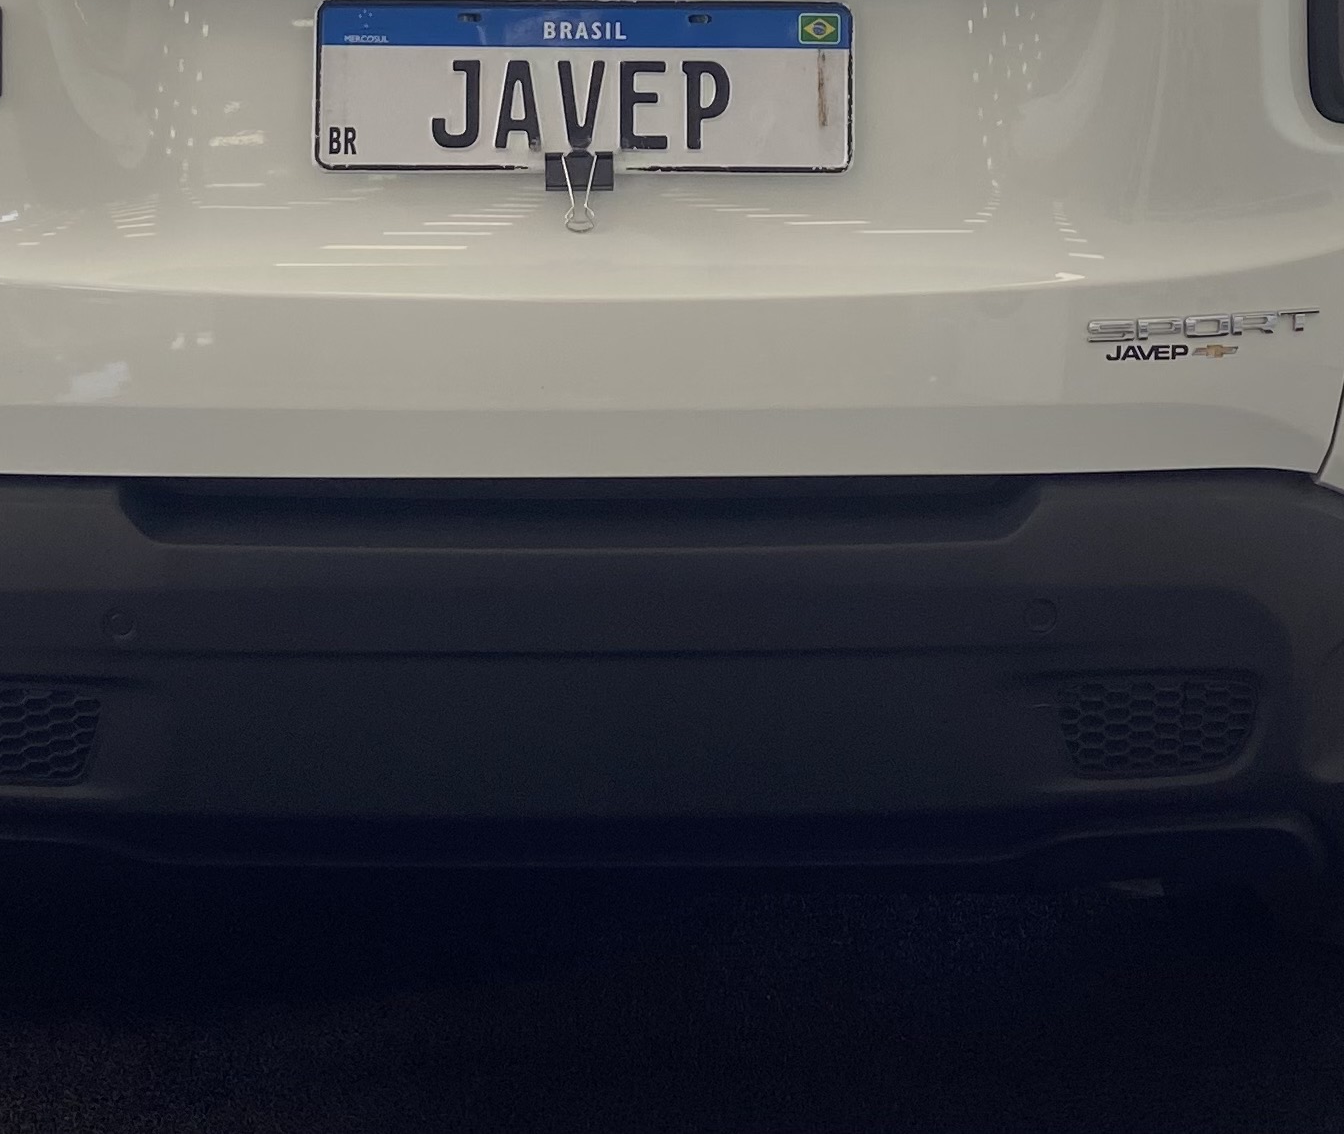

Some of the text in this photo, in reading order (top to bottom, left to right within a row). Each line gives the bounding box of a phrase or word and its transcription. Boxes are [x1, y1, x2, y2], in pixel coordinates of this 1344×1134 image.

[344, 34, 389, 43] MERCOSUL
[543, 21, 627, 40] BRASIL
[432, 60, 730, 150] JAVEP
[329, 127, 357, 155] BR
[1087, 307, 1320, 342] SPORT
[1106, 345, 1188, 360] JAVEP
